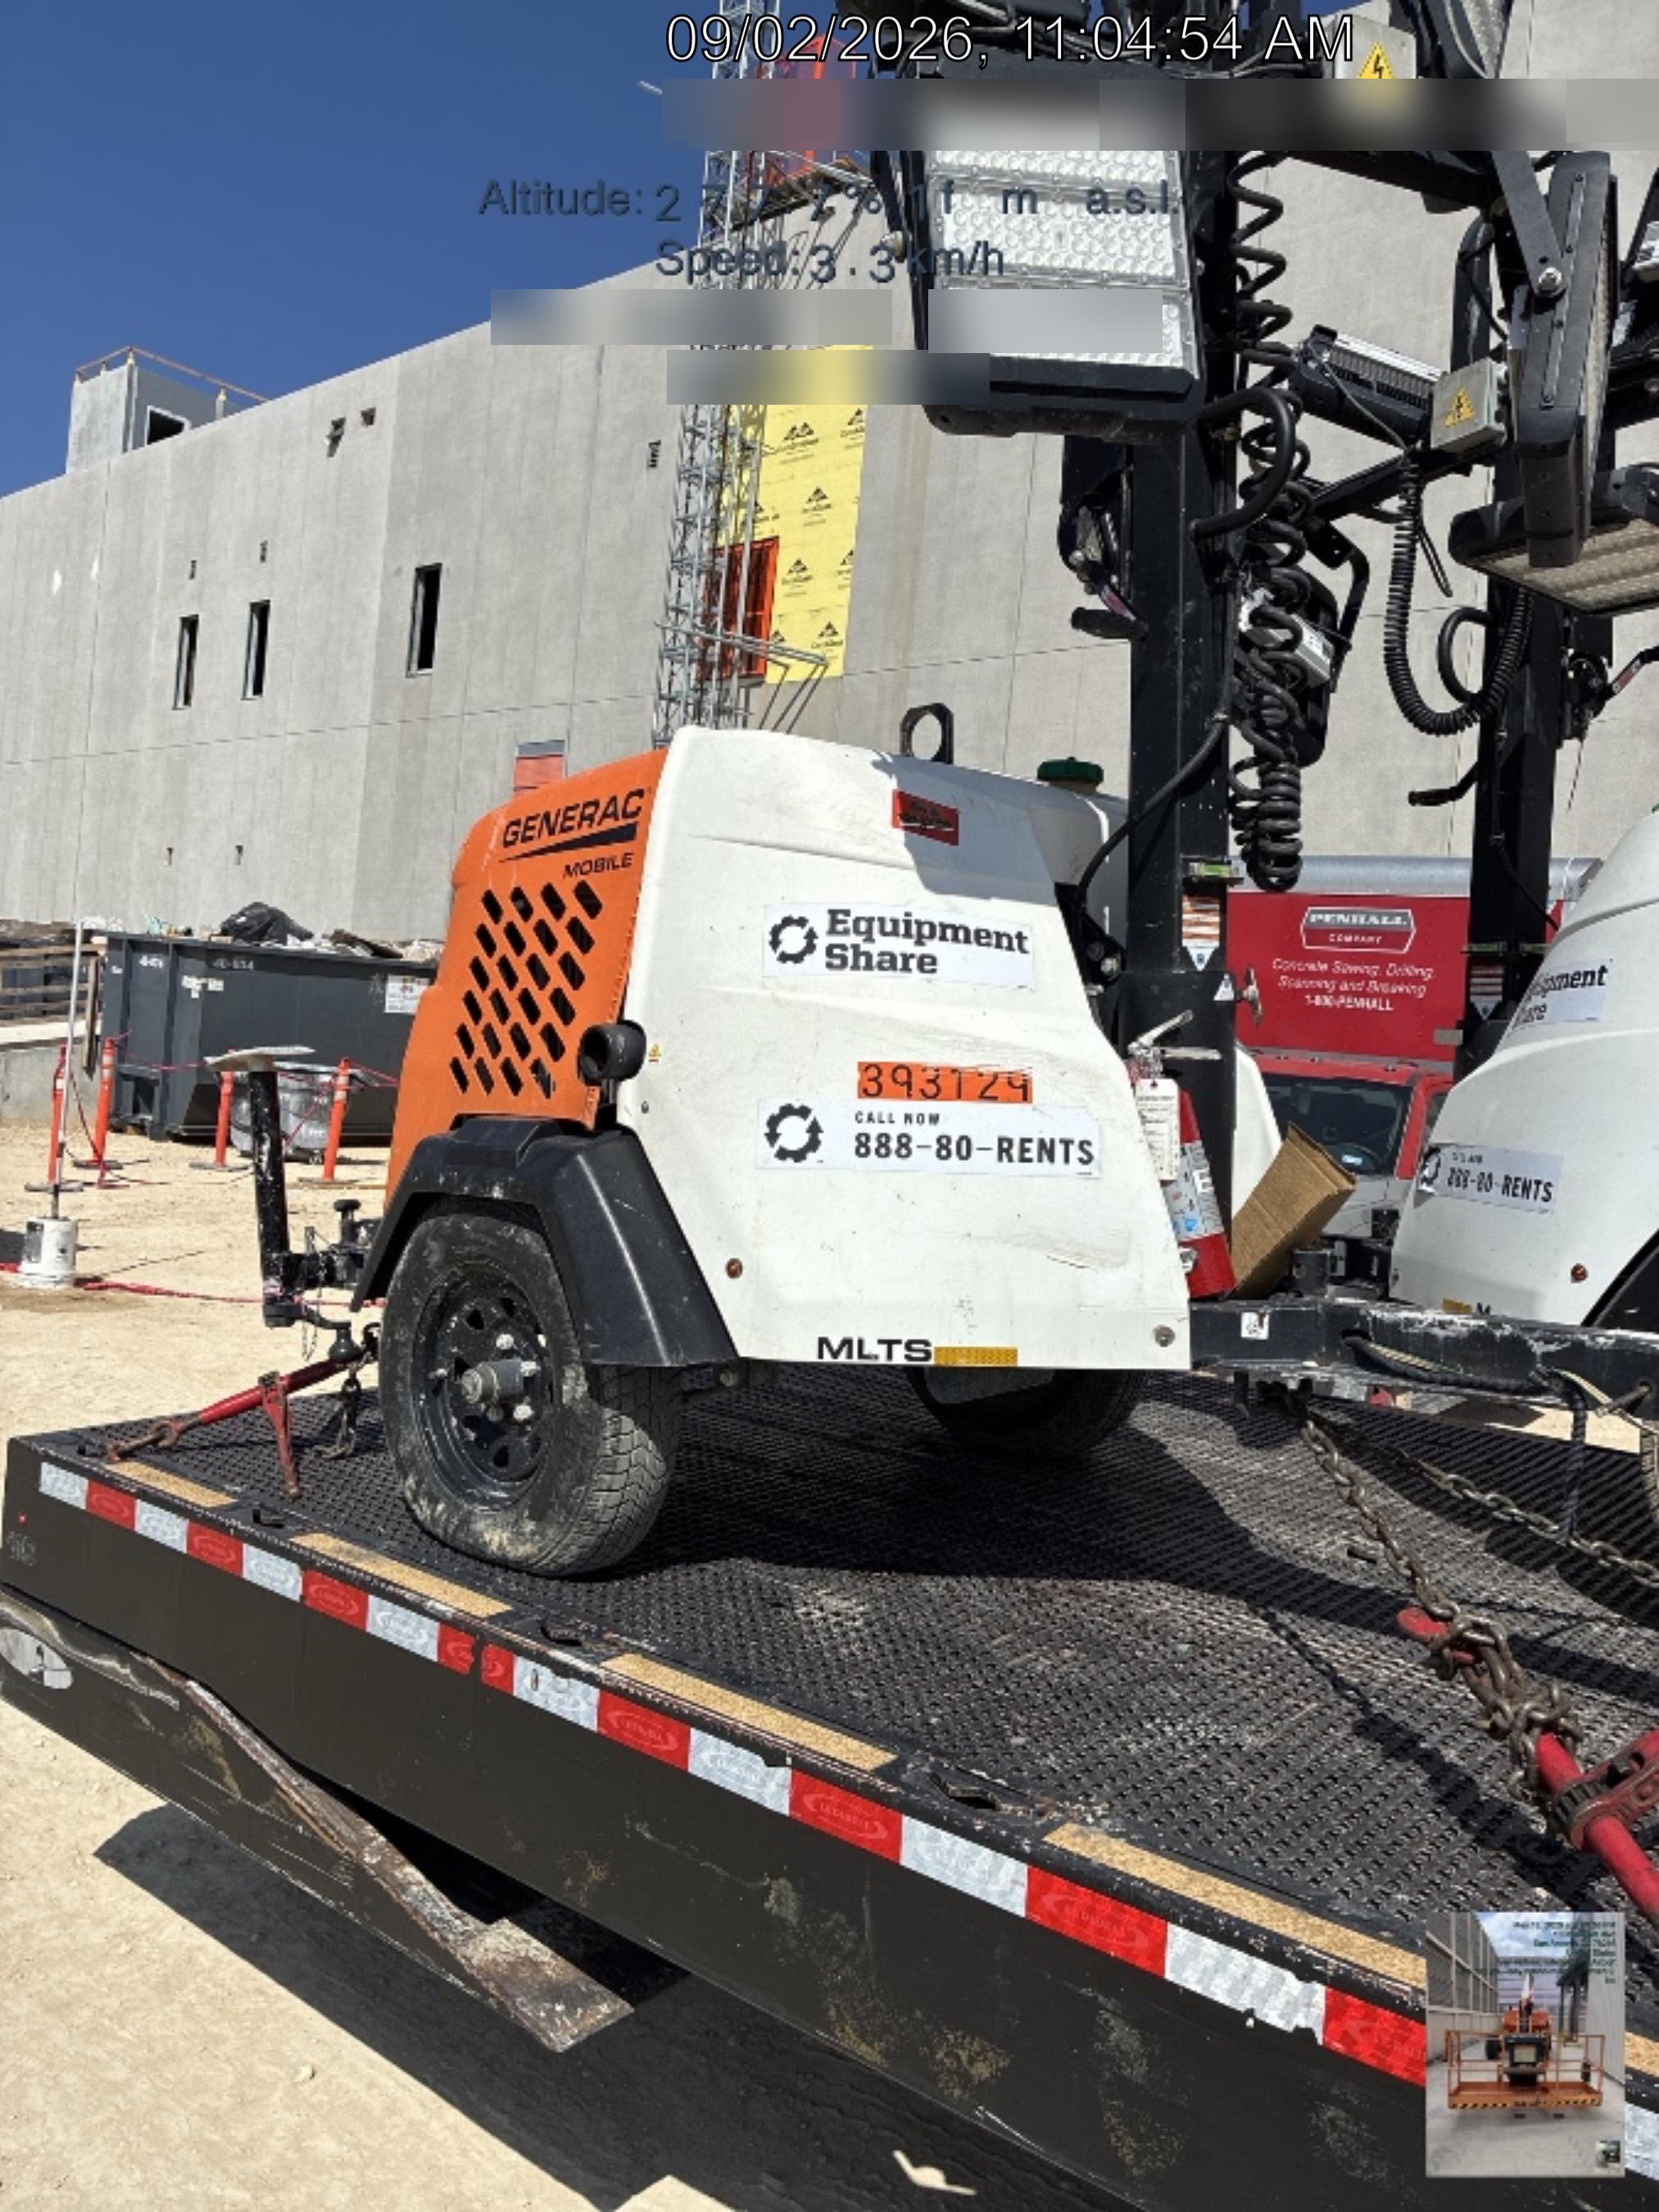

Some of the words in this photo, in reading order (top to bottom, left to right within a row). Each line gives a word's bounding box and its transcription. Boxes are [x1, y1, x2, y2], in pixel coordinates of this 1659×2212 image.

[501, 788, 645, 849] GENERAC
[563, 852, 634, 880] MOBILE
[825, 908, 1030, 954] Equipment
[1309, 913, 1407, 926] PENHALL
[825, 943, 938, 974] Share
[854, 1111, 896, 1125] CALL
[903, 1113, 941, 1126] NOW
[854, 1132, 1095, 1166] 888-80-RENTS
[817, 1336, 932, 1362] MLTS
